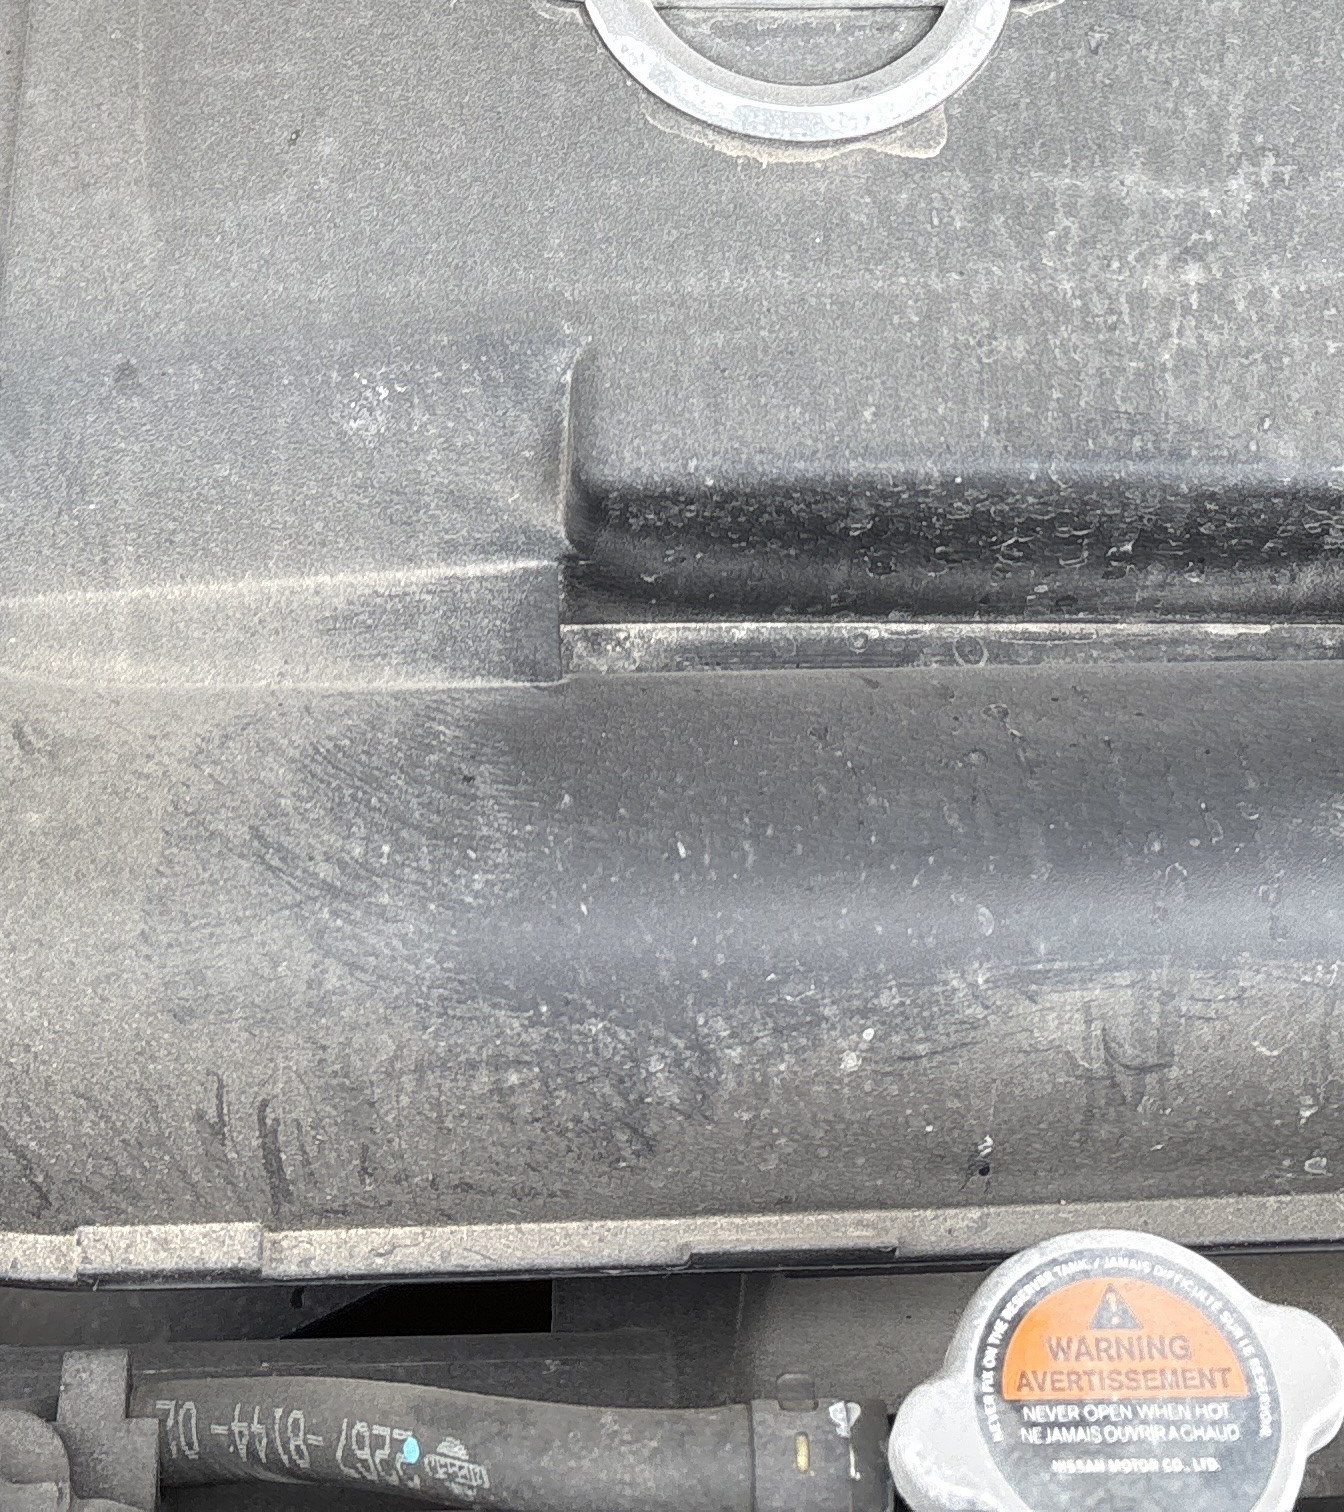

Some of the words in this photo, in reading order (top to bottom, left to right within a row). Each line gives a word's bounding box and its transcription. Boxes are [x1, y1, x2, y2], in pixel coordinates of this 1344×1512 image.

[1047, 1334, 1193, 1363] WARNING
[1017, 1367, 1232, 1392] AVERTISSEMENT
[1022, 1405, 1080, 1422] NEVER
[1084, 1404, 1132, 1422] OPEN
[1136, 1402, 1191, 1420] WHEN
[1195, 1401, 1230, 1419] HOT
[1020, 1426, 1042, 1444] NE
[1045, 1425, 1102, 1444] JAMAIS
[1180, 1423, 1240, 1442] CHAUD
[1051, 1459, 1105, 1474] NISSAN
[1107, 1458, 1159, 1473] MOTOR
